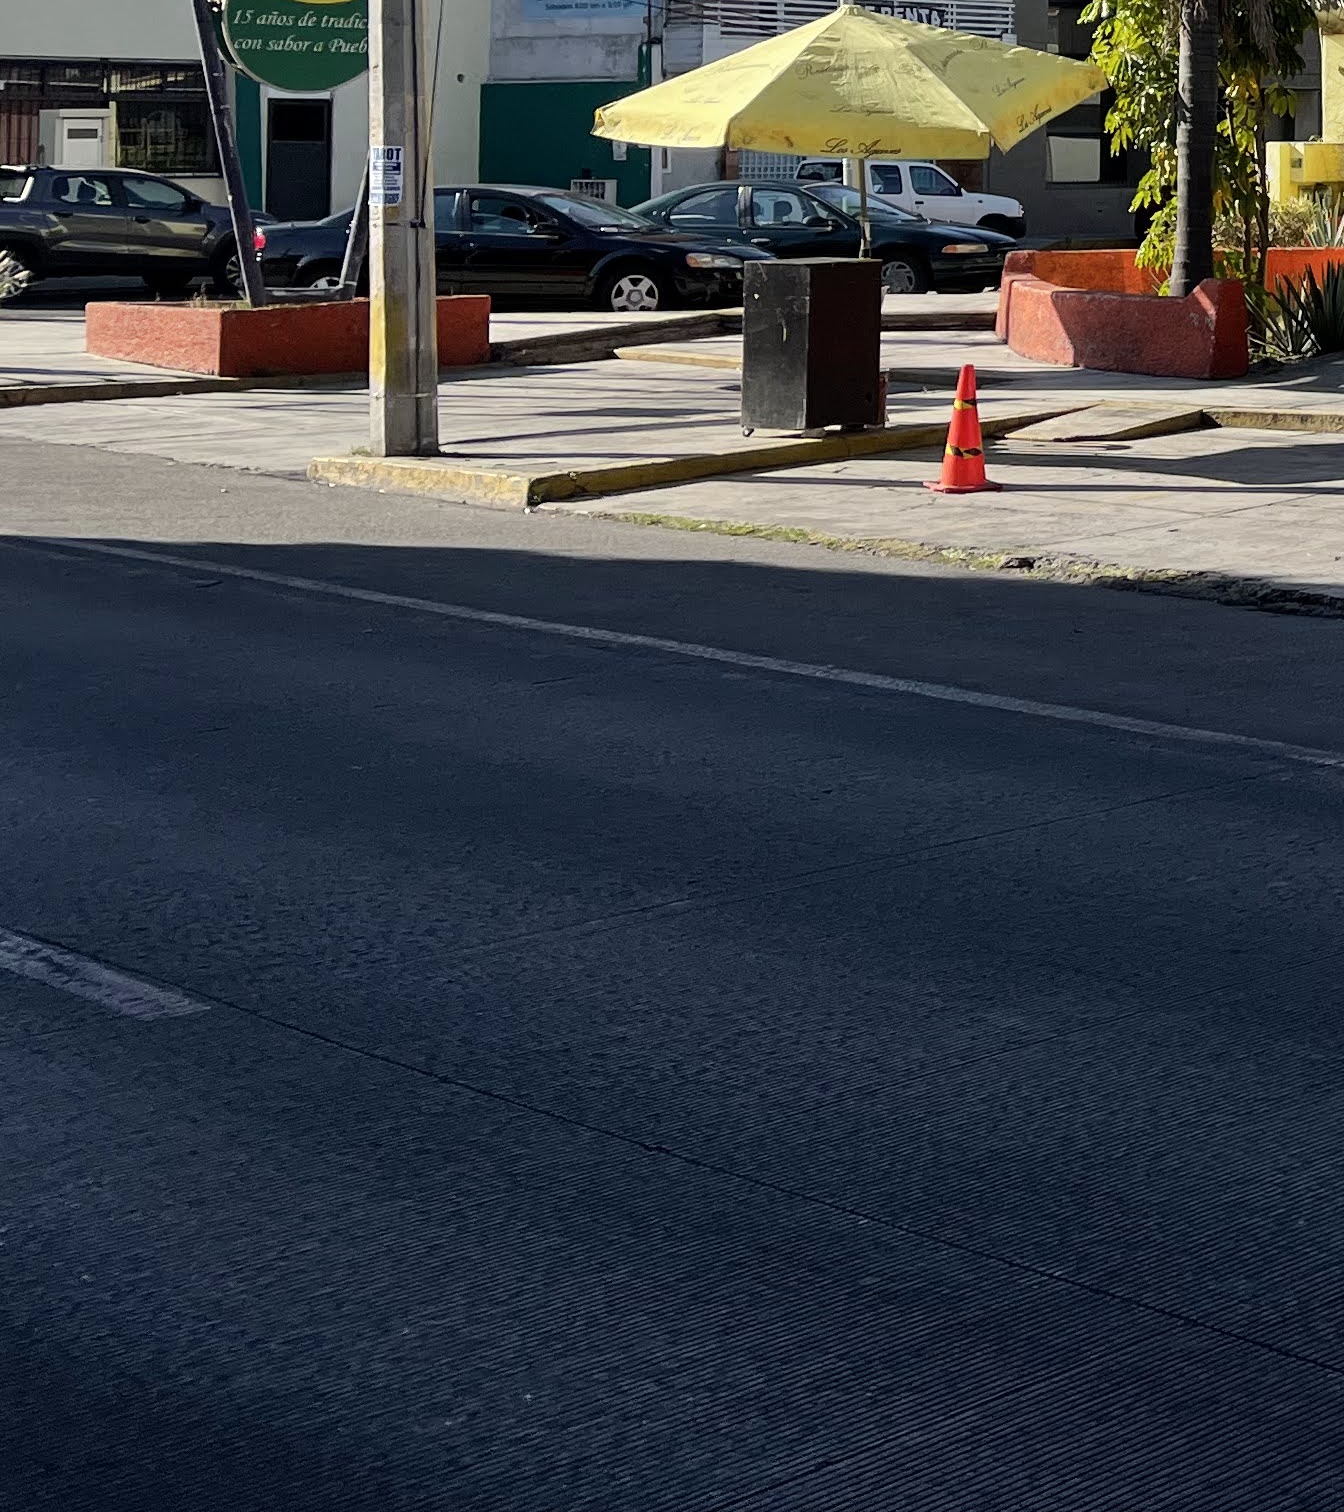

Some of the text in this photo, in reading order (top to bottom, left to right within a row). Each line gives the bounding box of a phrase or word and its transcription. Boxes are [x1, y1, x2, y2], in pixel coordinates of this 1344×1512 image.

[232, 9, 367, 30] 15 años de tradic
[233, 34, 367, 54] con sabor a Pueb
